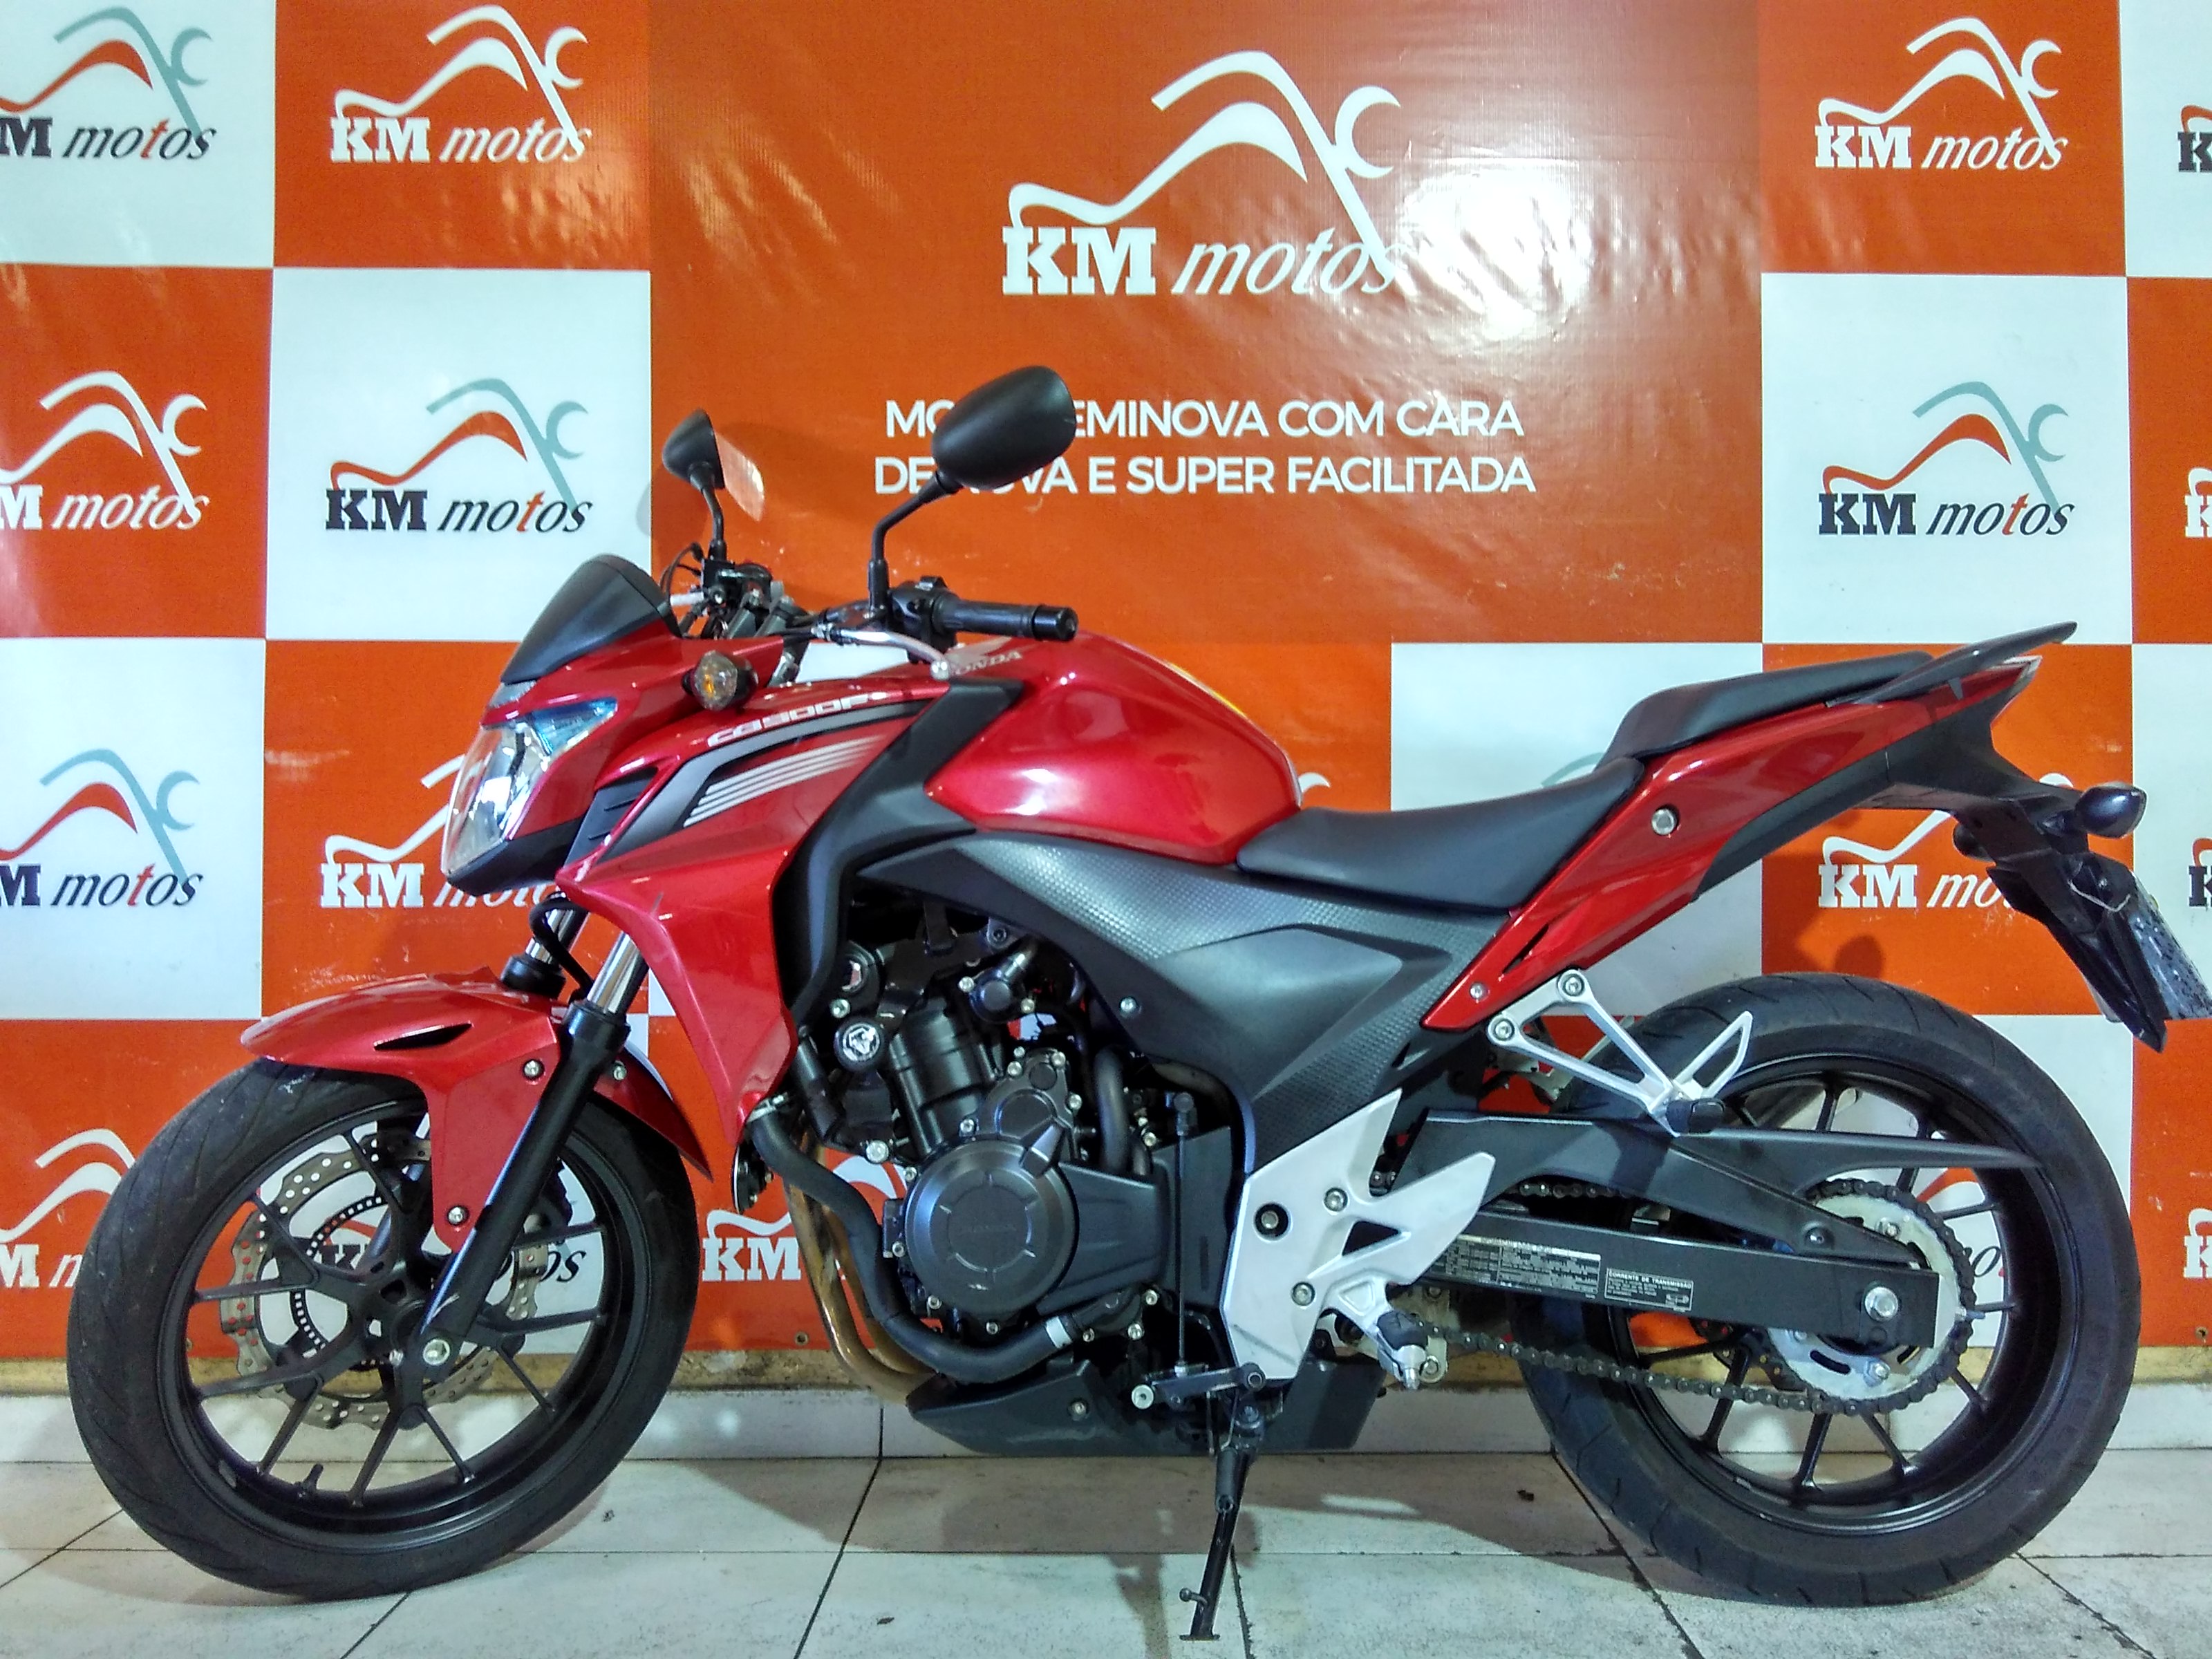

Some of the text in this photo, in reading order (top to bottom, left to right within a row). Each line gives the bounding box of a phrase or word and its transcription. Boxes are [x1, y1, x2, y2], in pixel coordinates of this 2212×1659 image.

[0, 117, 217, 159] M motos
[330, 117, 592, 163] KM motos
[1815, 126, 2068, 170] KM motos
[1001, 226, 1403, 295] KM motos
[1074, 399, 1269, 438] EMINOVA
[1278, 399, 1384, 438] COM
[1396, 399, 1524, 438] CARA
[874, 456, 935, 494] DE
[1089, 456, 1115, 493] E
[1127, 456, 1273, 494] SUPER
[1287, 456, 1536, 494] FACILITADA
[0, 484, 210, 530] M motos
[326, 489, 593, 533] KM motos
[1818, 493, 2075, 536] KM motos
[0, 863, 203, 906] M motos
[321, 863, 424, 908] KM
[1819, 864, 1918, 908] KM
[702, 1237, 801, 1282] KM
